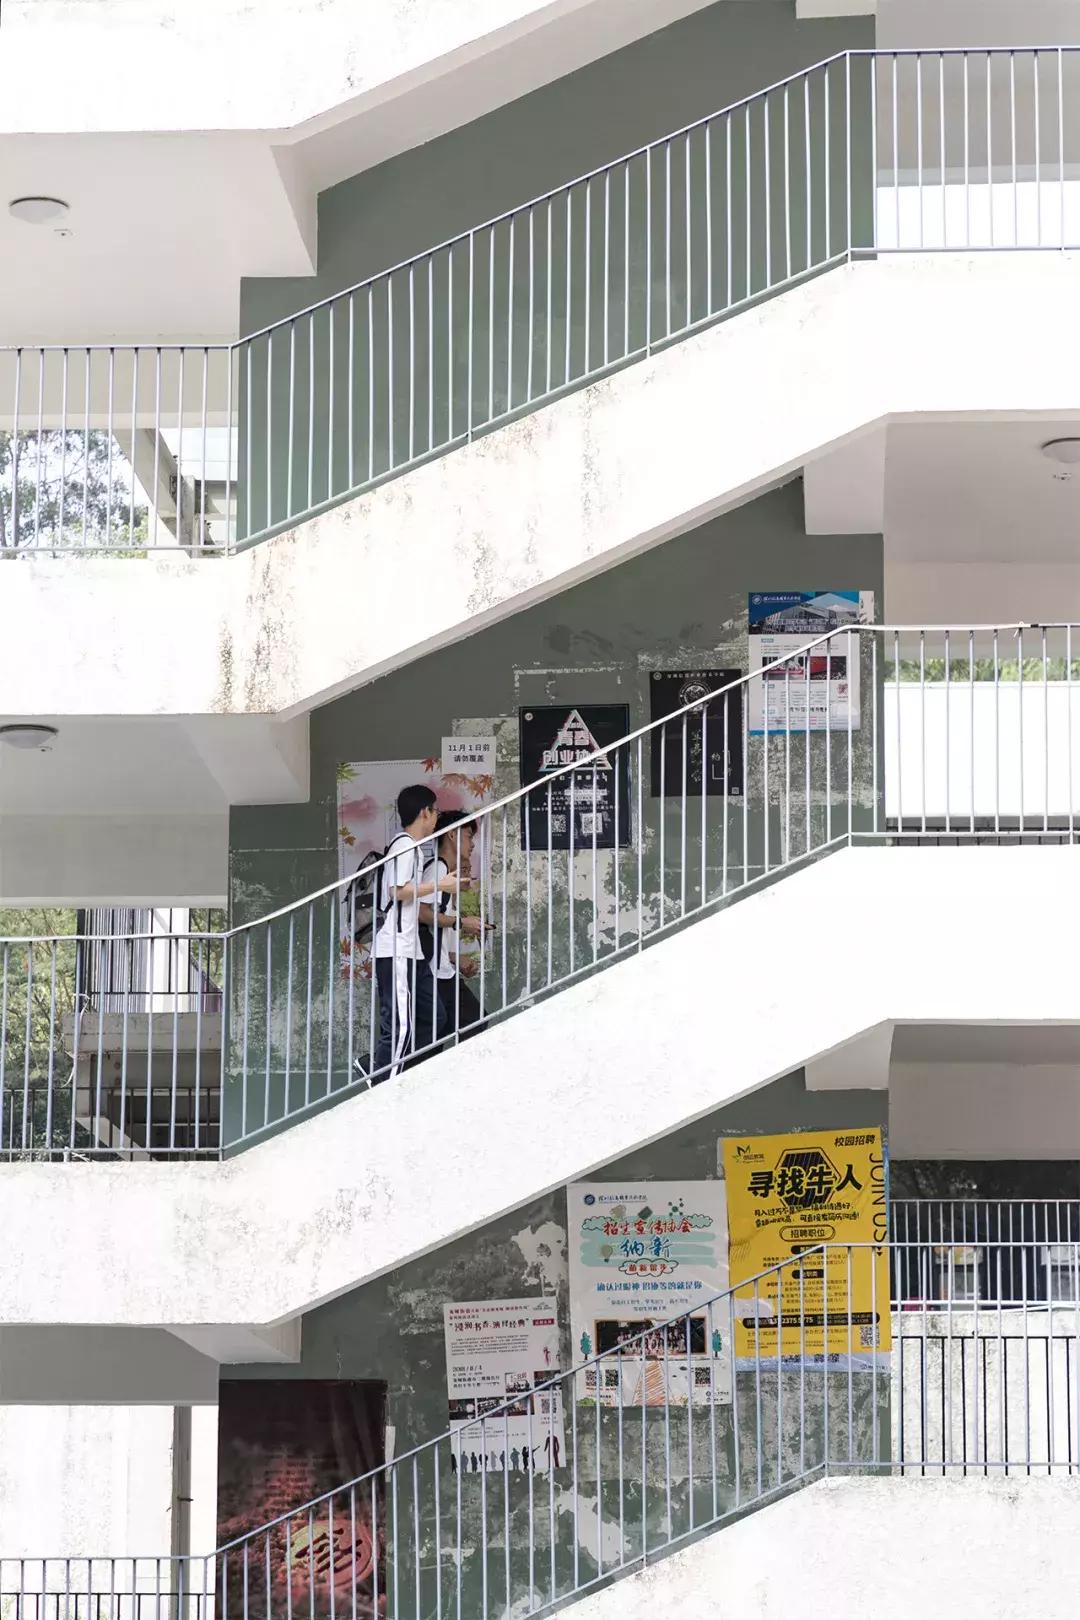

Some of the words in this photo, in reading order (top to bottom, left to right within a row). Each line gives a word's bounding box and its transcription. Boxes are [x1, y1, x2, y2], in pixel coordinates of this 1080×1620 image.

[454, 754, 484, 763] 请勿覆盖
[834, 1134, 876, 1148] 校园招聘
[747, 1163, 863, 1199] 寻找牛人
[868, 1152, 888, 1206] JOIN
[602, 1218, 694, 1236] 招生宣传协会
[790, 1228, 826, 1239] 招聘职位
[872, 1214, 889, 1243] US
[620, 1236, 671, 1258] 纳新
